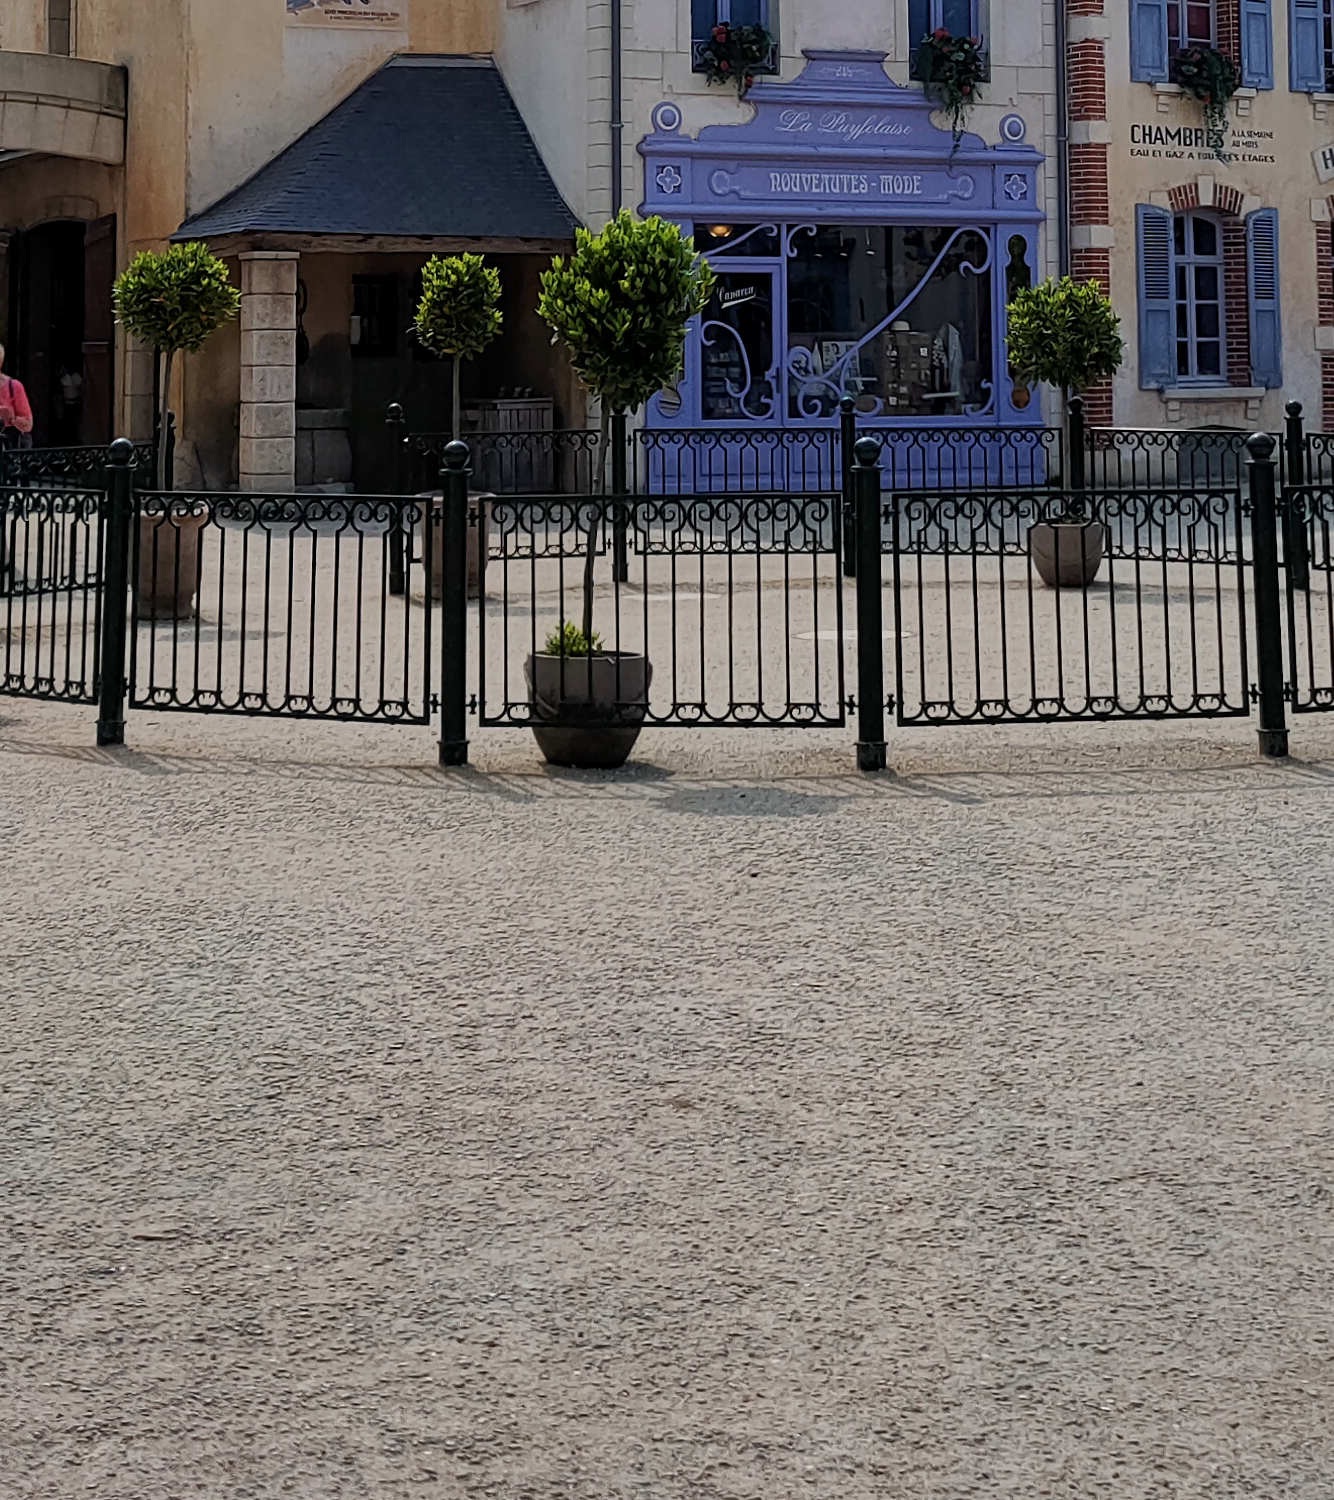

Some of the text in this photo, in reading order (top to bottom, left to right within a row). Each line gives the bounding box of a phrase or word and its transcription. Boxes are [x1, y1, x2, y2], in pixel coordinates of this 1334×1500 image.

[775, 109, 813, 132] La
[1130, 148, 1149, 157] EAU
[1152, 149, 1162, 158] ET
[1165, 150, 1184, 159] GAZ
[1197, 152, 1222, 161] TOU
[769, 172, 868, 194] NOUVEAUTES
[880, 175, 922, 195] MODE
